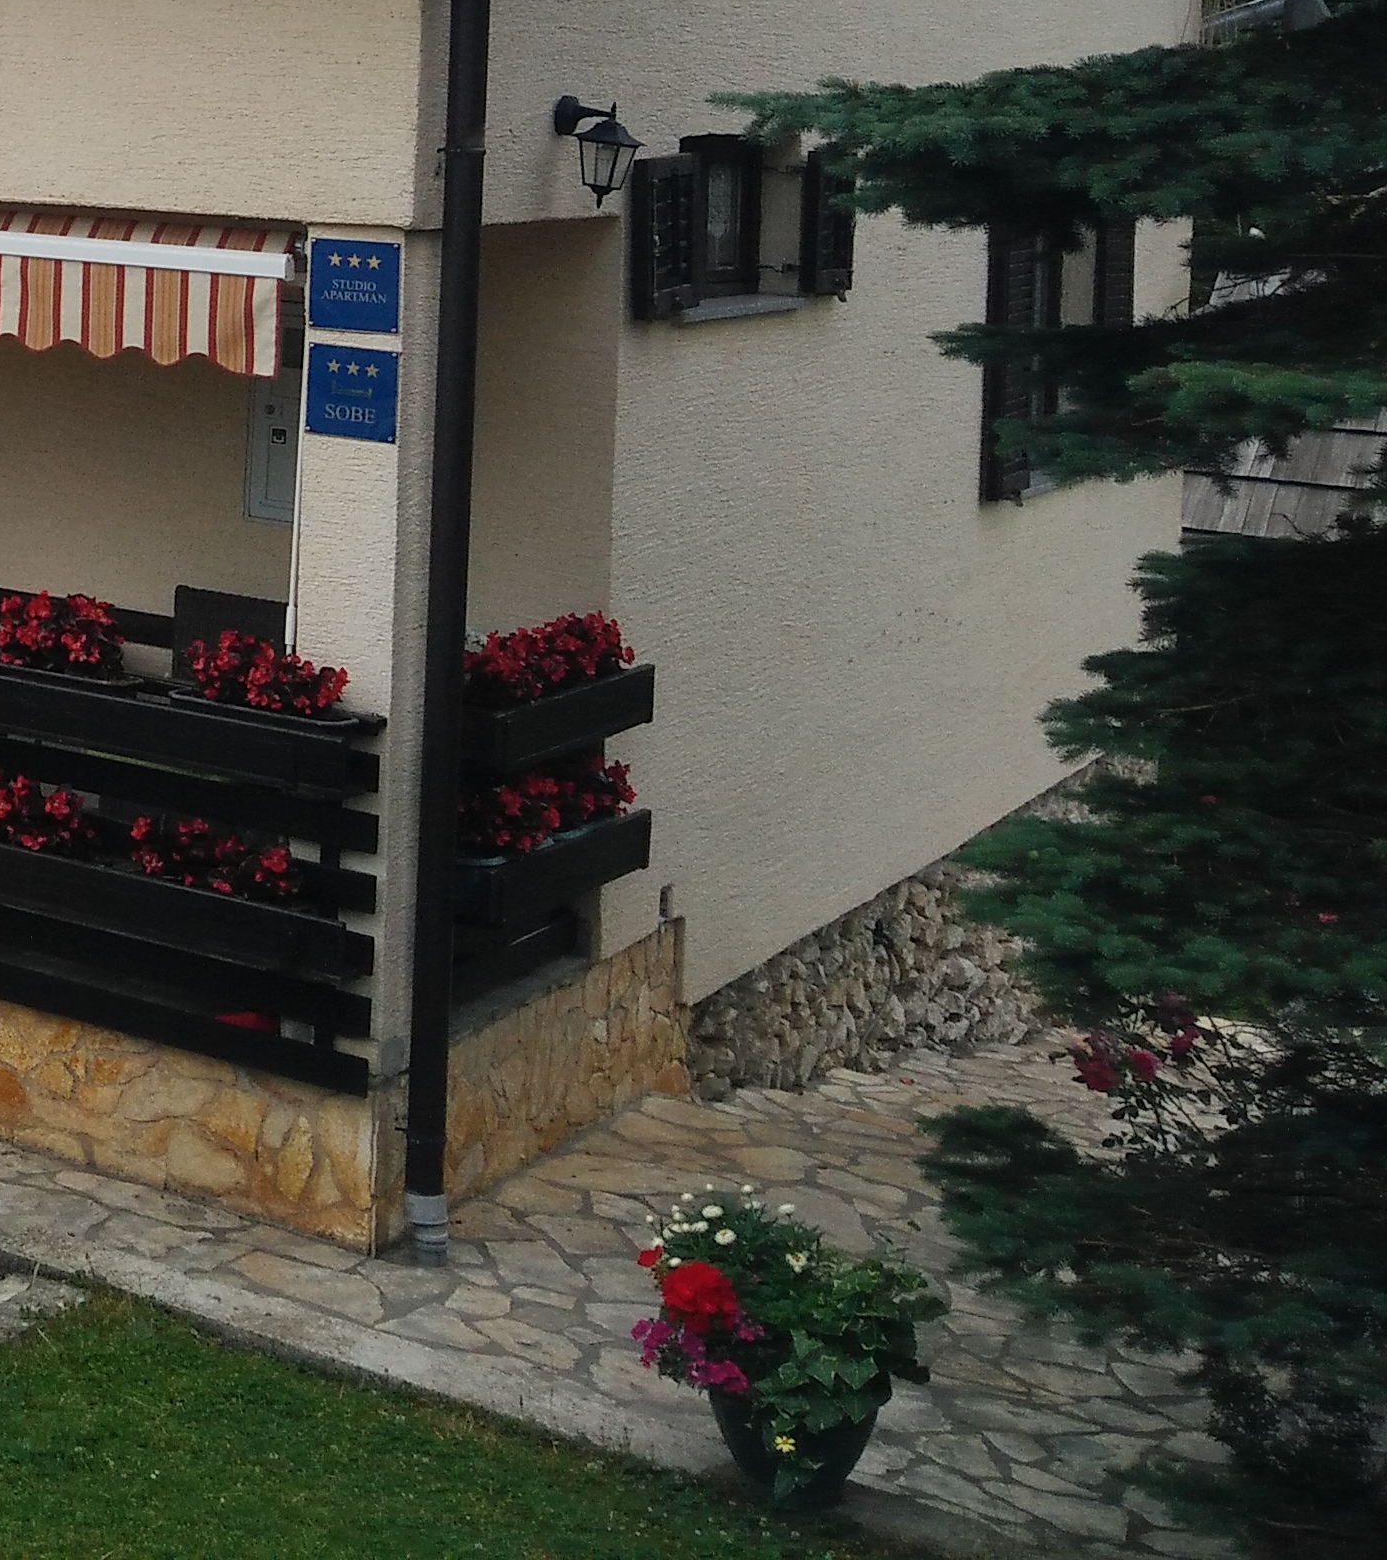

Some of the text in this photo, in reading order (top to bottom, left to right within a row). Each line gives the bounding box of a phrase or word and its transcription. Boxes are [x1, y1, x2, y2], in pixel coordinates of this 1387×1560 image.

[331, 279, 377, 292] STUDIO
[320, 290, 387, 304] APARTMAN
[324, 403, 376, 424] SOBE
